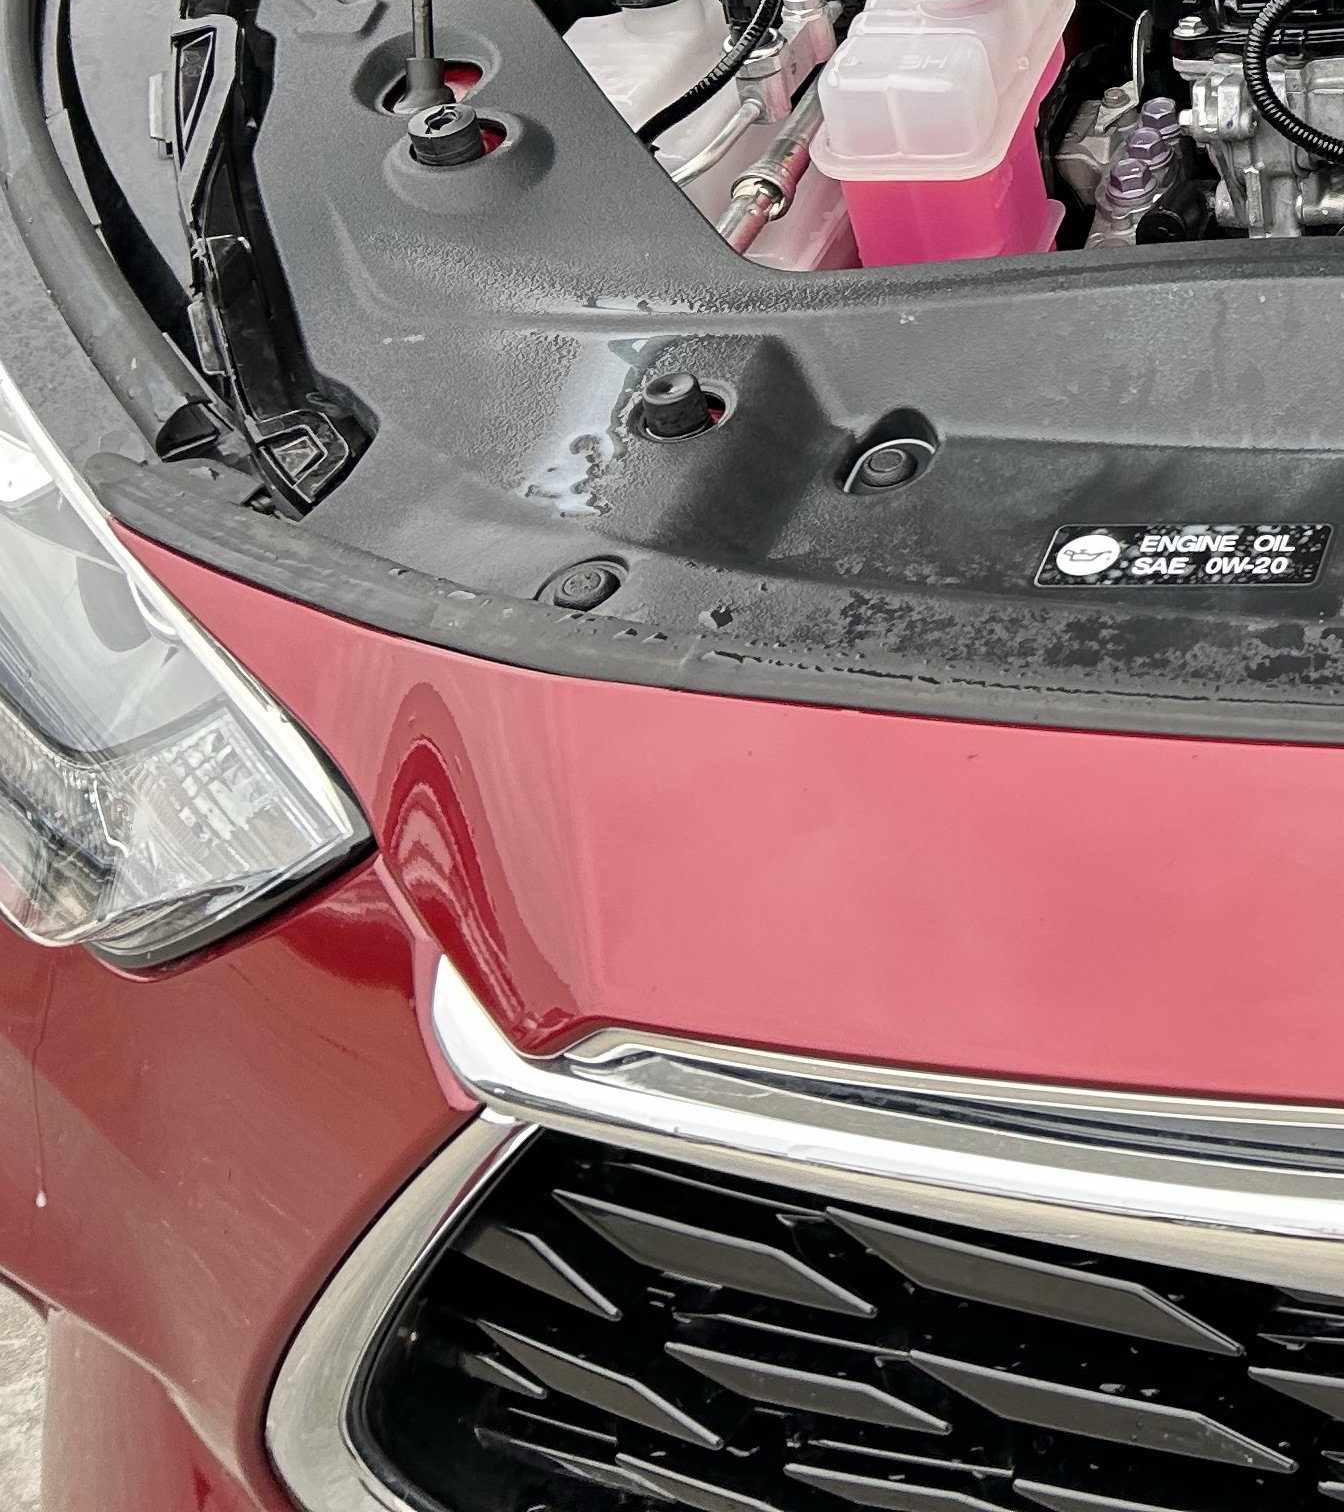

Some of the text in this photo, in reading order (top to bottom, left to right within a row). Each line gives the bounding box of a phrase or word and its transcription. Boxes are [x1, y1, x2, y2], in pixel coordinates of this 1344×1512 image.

[1139, 534, 1297, 553] ENGINE OIL
[1130, 556, 1190, 575] SAE
